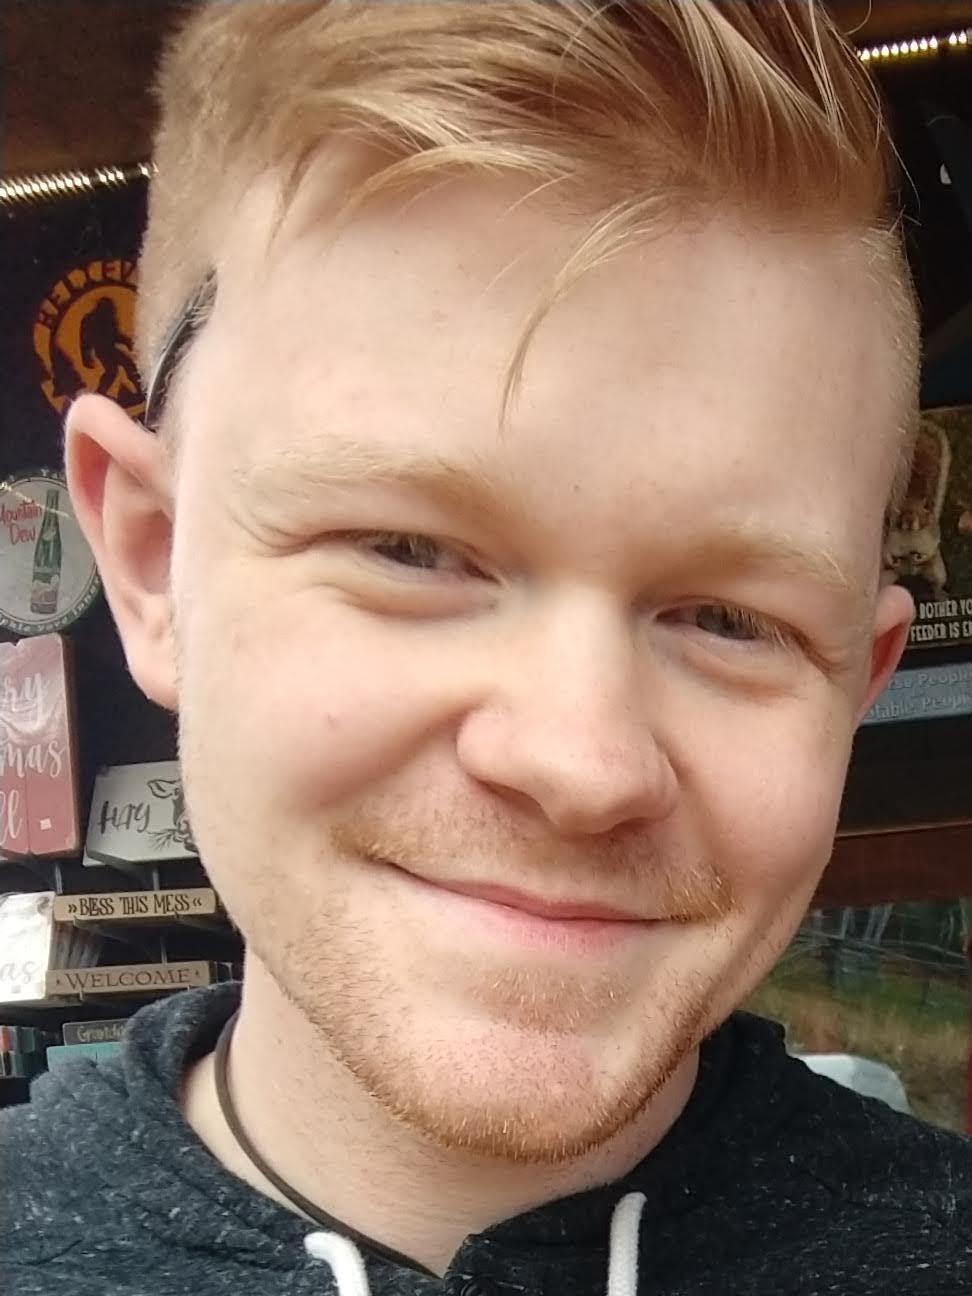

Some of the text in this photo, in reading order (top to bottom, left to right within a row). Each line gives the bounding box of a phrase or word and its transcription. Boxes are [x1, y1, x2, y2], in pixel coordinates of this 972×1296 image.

[9, 522, 36, 545] Dew
[920, 600, 958, 619] BOTHER
[910, 623, 947, 641] FEEDER
[949, 621, 960, 638] IS
[80, 893, 190, 917] BLESS THIS MESS
[66, 968, 191, 990] WELCOME
